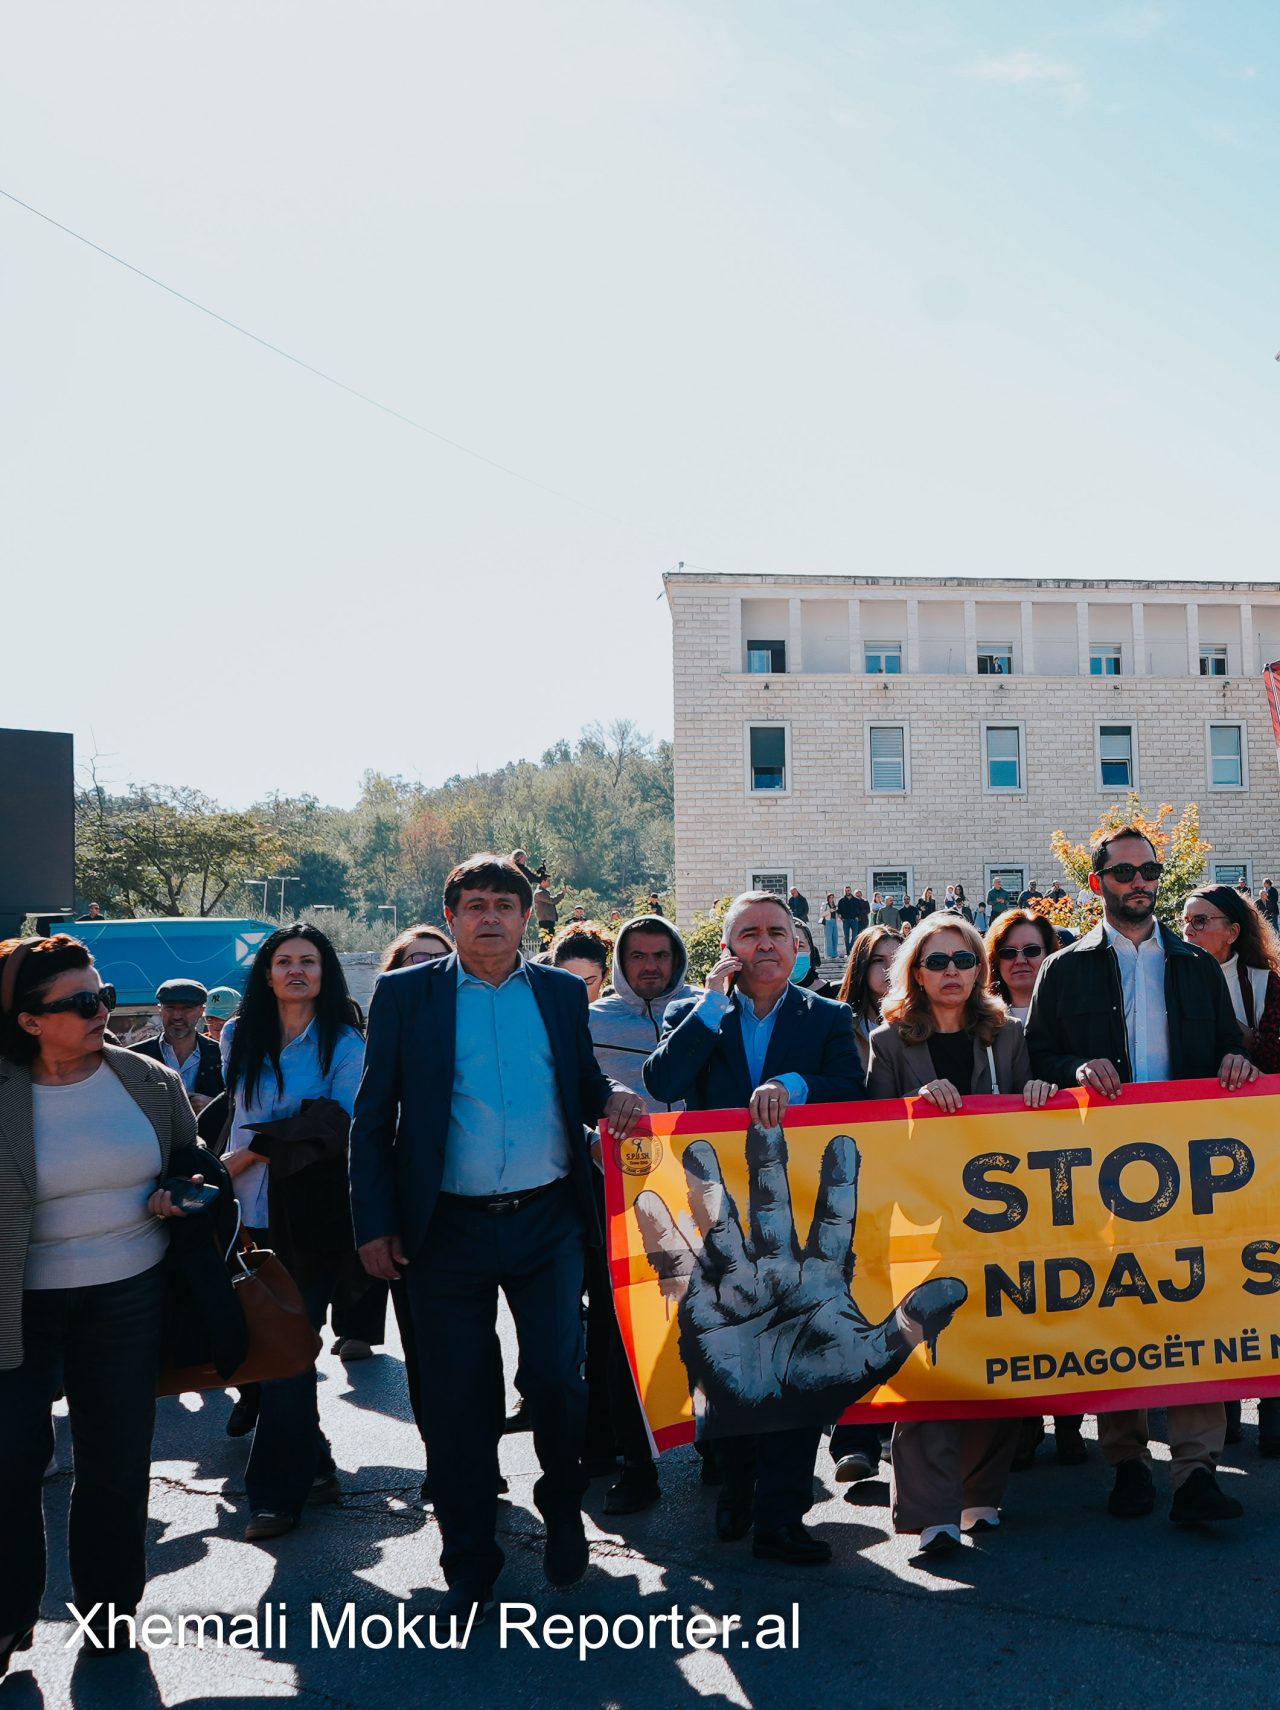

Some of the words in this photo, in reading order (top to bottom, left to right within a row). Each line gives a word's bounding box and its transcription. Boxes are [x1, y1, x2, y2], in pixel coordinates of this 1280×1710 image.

[962, 1137, 1255, 1233] STOP
[984, 1246, 1205, 1318] NDAJ
[986, 1334, 1205, 1385] PEDAGOGËT
[1214, 1327, 1261, 1364] NË
